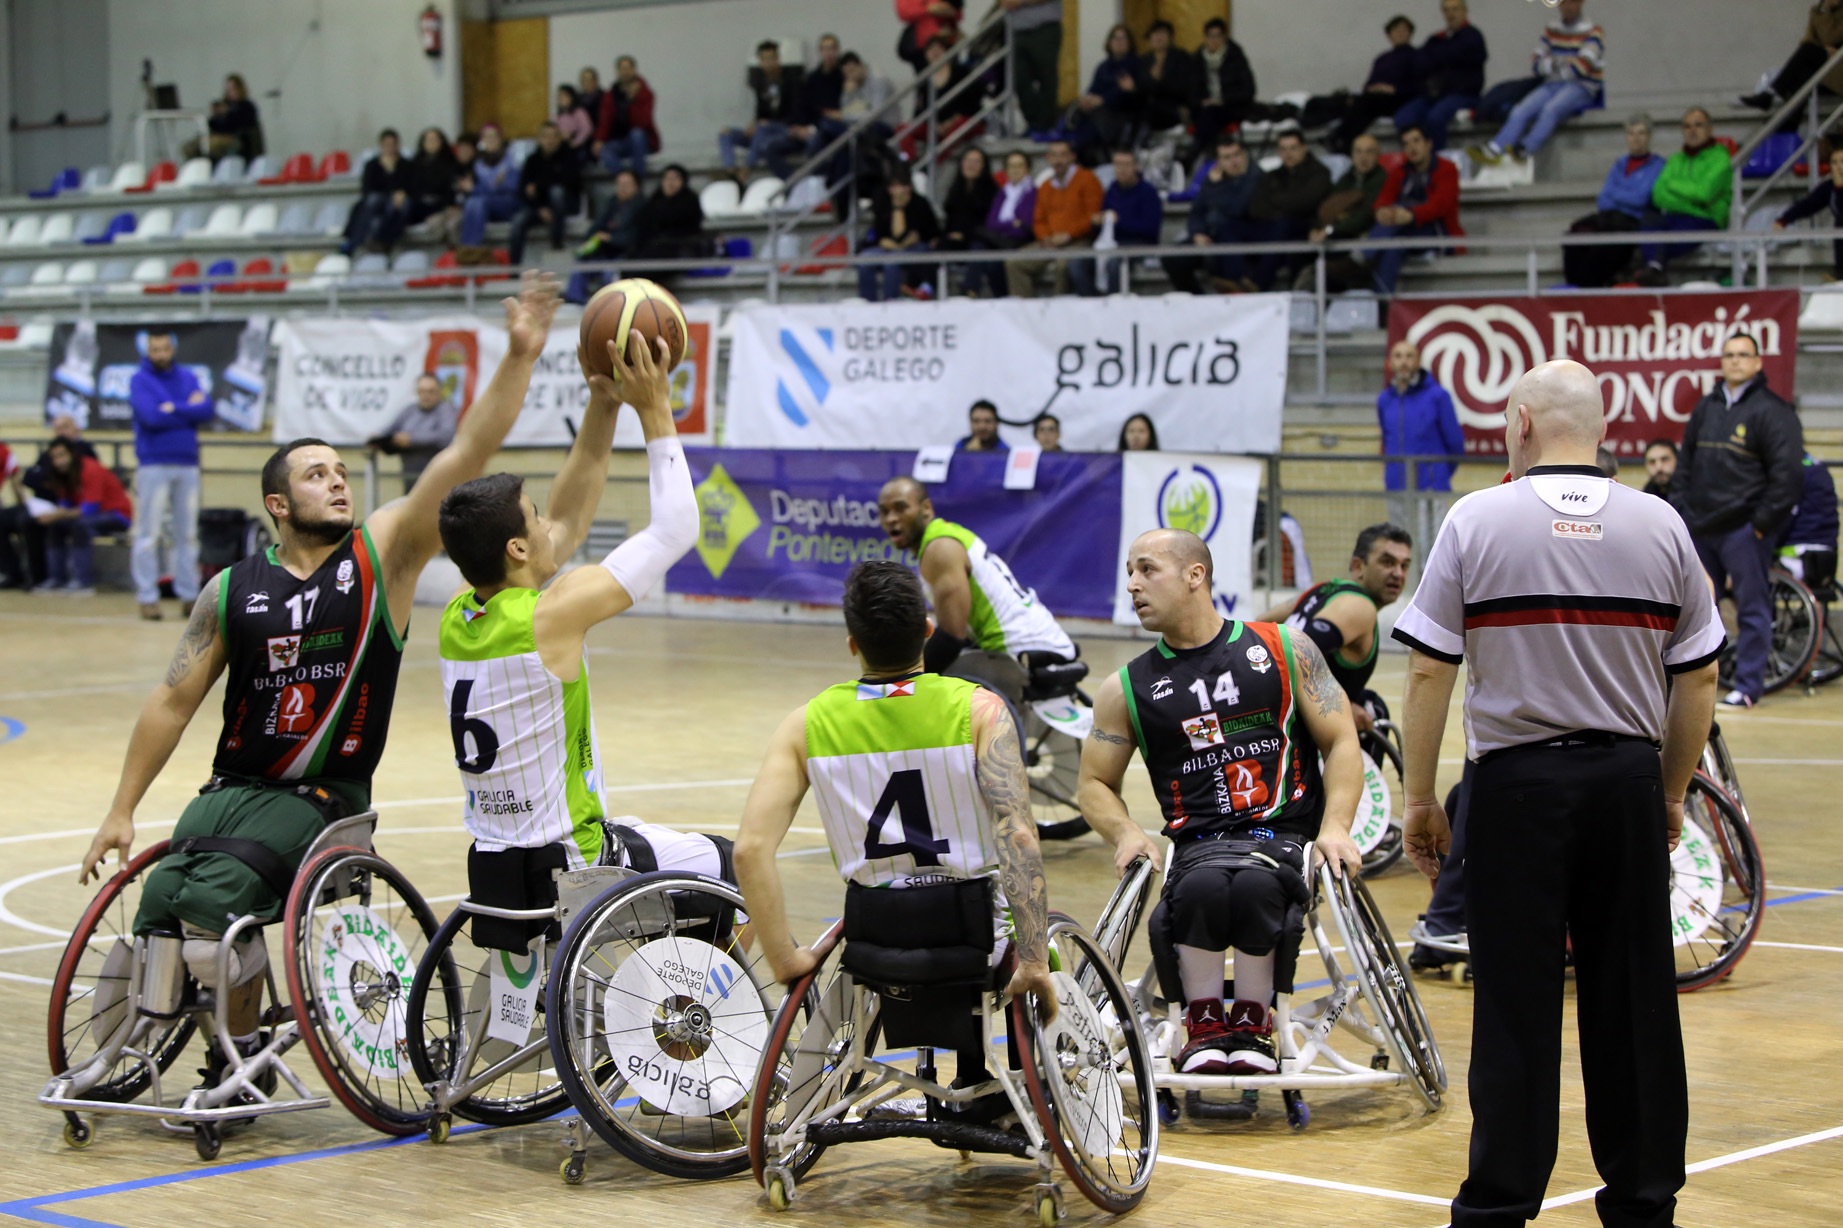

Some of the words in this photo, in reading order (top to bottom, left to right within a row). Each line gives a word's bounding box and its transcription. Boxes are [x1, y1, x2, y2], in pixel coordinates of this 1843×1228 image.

[844, 323, 958, 351] DEPORTE
[294, 353, 406, 379] CONCELLO
[843, 355, 946, 383] GALEGO
[1056, 322, 1240, 392] galicia
[769, 489, 881, 533] Deputac
[1561, 491, 1588, 503] vive
[284, 585, 321, 631] 17
[311, 662, 346, 680] BSR
[1188, 670, 1240, 712] 14
[451, 679, 499, 775] 6
[1182, 746, 1245, 775] BILBAO
[1249, 738, 1280, 756] BSR
[477, 789, 515, 802] GALICIA
[1213, 766, 1231, 814] BIZKAIA
[864, 768, 951, 867] 4
[657, 967, 702, 991] DEPORTE
[663, 960, 704, 980] GALEGO
[501, 993, 527, 1013] GALICIA
[628, 1055, 711, 1100] galicia
